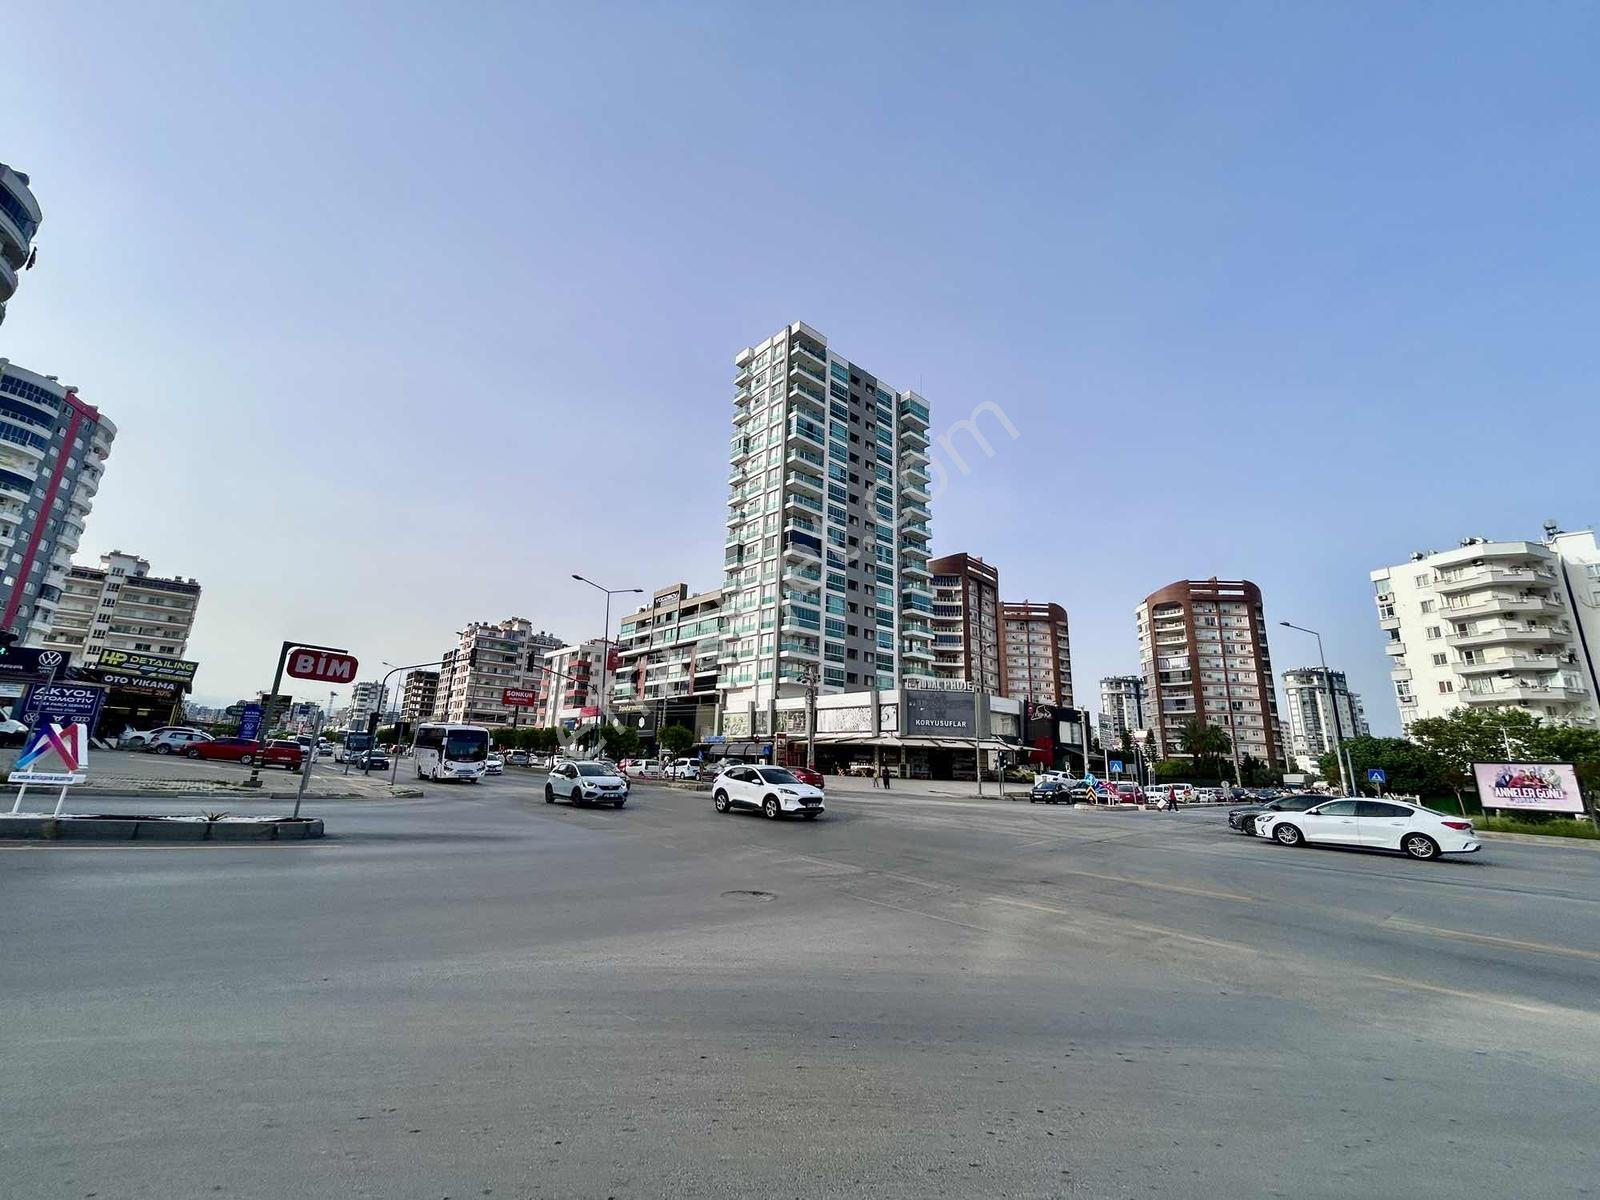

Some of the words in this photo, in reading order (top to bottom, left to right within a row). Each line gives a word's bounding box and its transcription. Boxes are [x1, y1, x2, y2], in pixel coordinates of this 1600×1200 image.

[101, 650, 128, 665] HP
[130, 655, 195, 671] DETAILING
[104, 674, 129, 685] OTO
[132, 678, 175, 691] YIKAMA
[35, 686, 96, 698] AKYOL
[915, 719, 967, 728] KORYUSUFLAR
[1495, 787, 1536, 799] ANNELER
